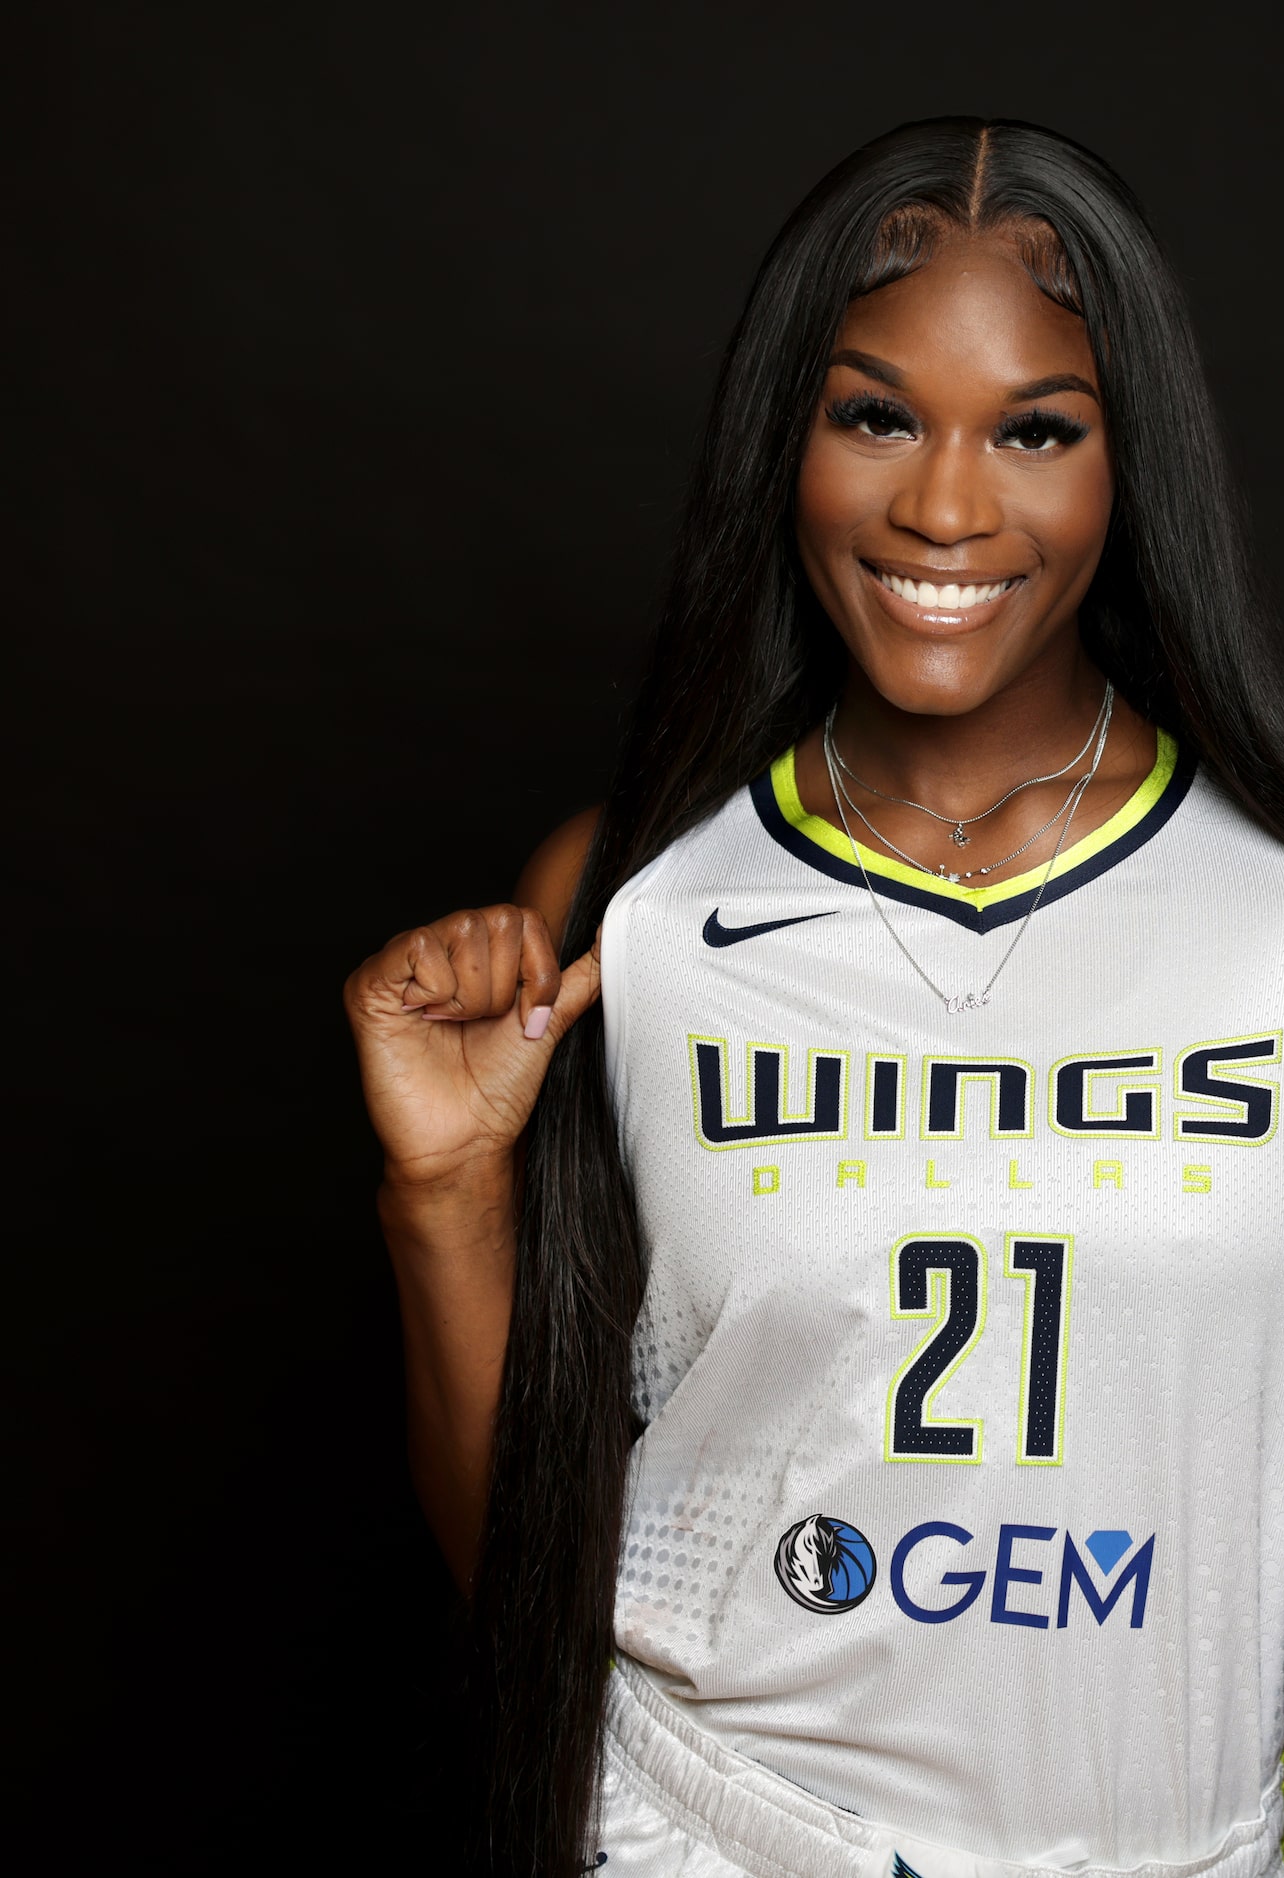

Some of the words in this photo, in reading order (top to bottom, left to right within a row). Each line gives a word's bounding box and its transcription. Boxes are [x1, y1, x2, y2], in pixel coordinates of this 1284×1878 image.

[688, 1029, 1284, 1153] WINGS
[753, 1160, 1213, 1197] DALLAS
[884, 1232, 1075, 1468] 21
[890, 1521, 1156, 1630] GEM
